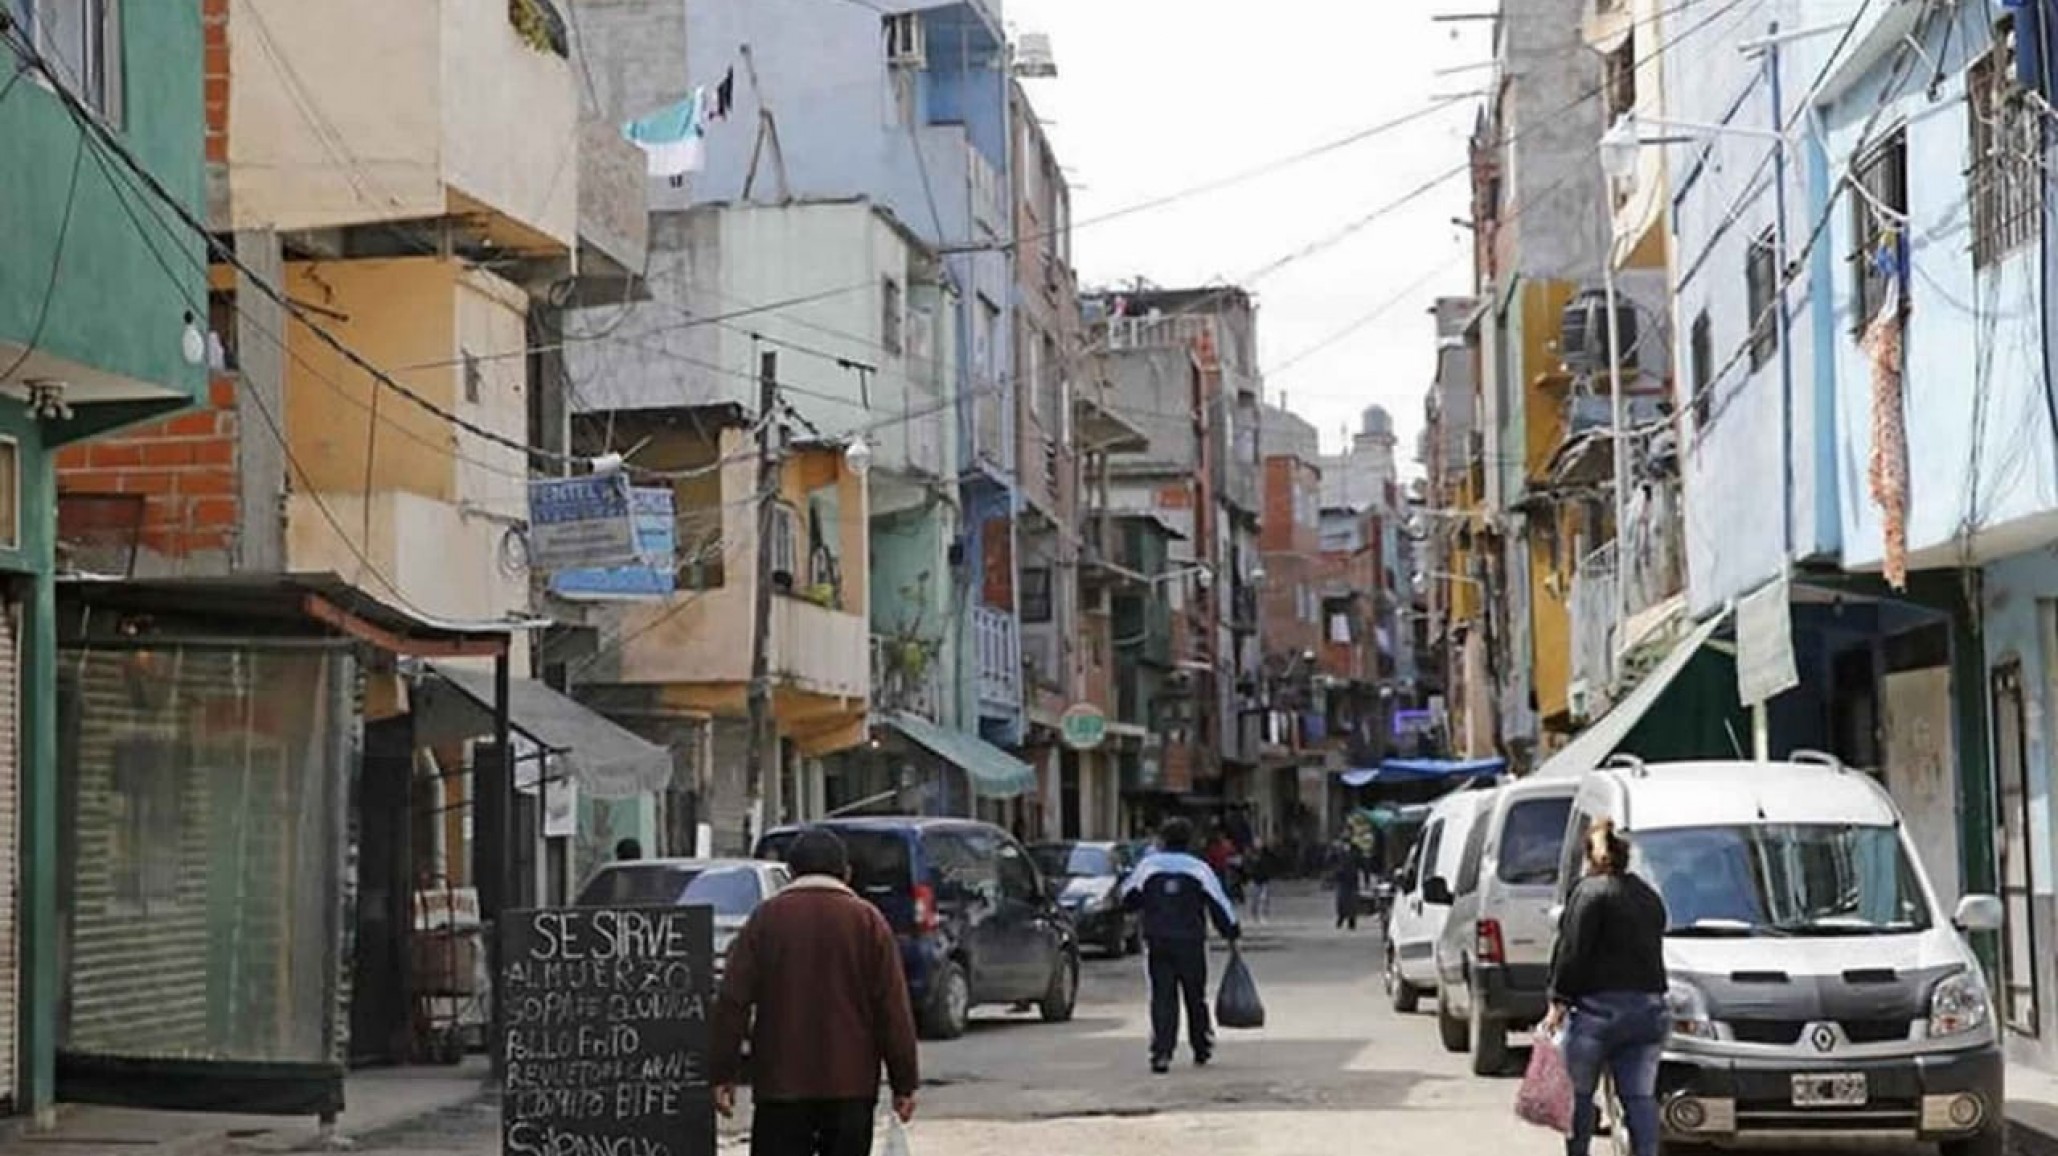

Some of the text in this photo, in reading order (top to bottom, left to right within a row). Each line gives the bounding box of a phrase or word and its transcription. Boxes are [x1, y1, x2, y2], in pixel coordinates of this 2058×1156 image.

[531, 910, 689, 959] SE SIRVE
[506, 959, 692, 991] ALMUERZO
[616, 1081, 682, 1120] BIFE
